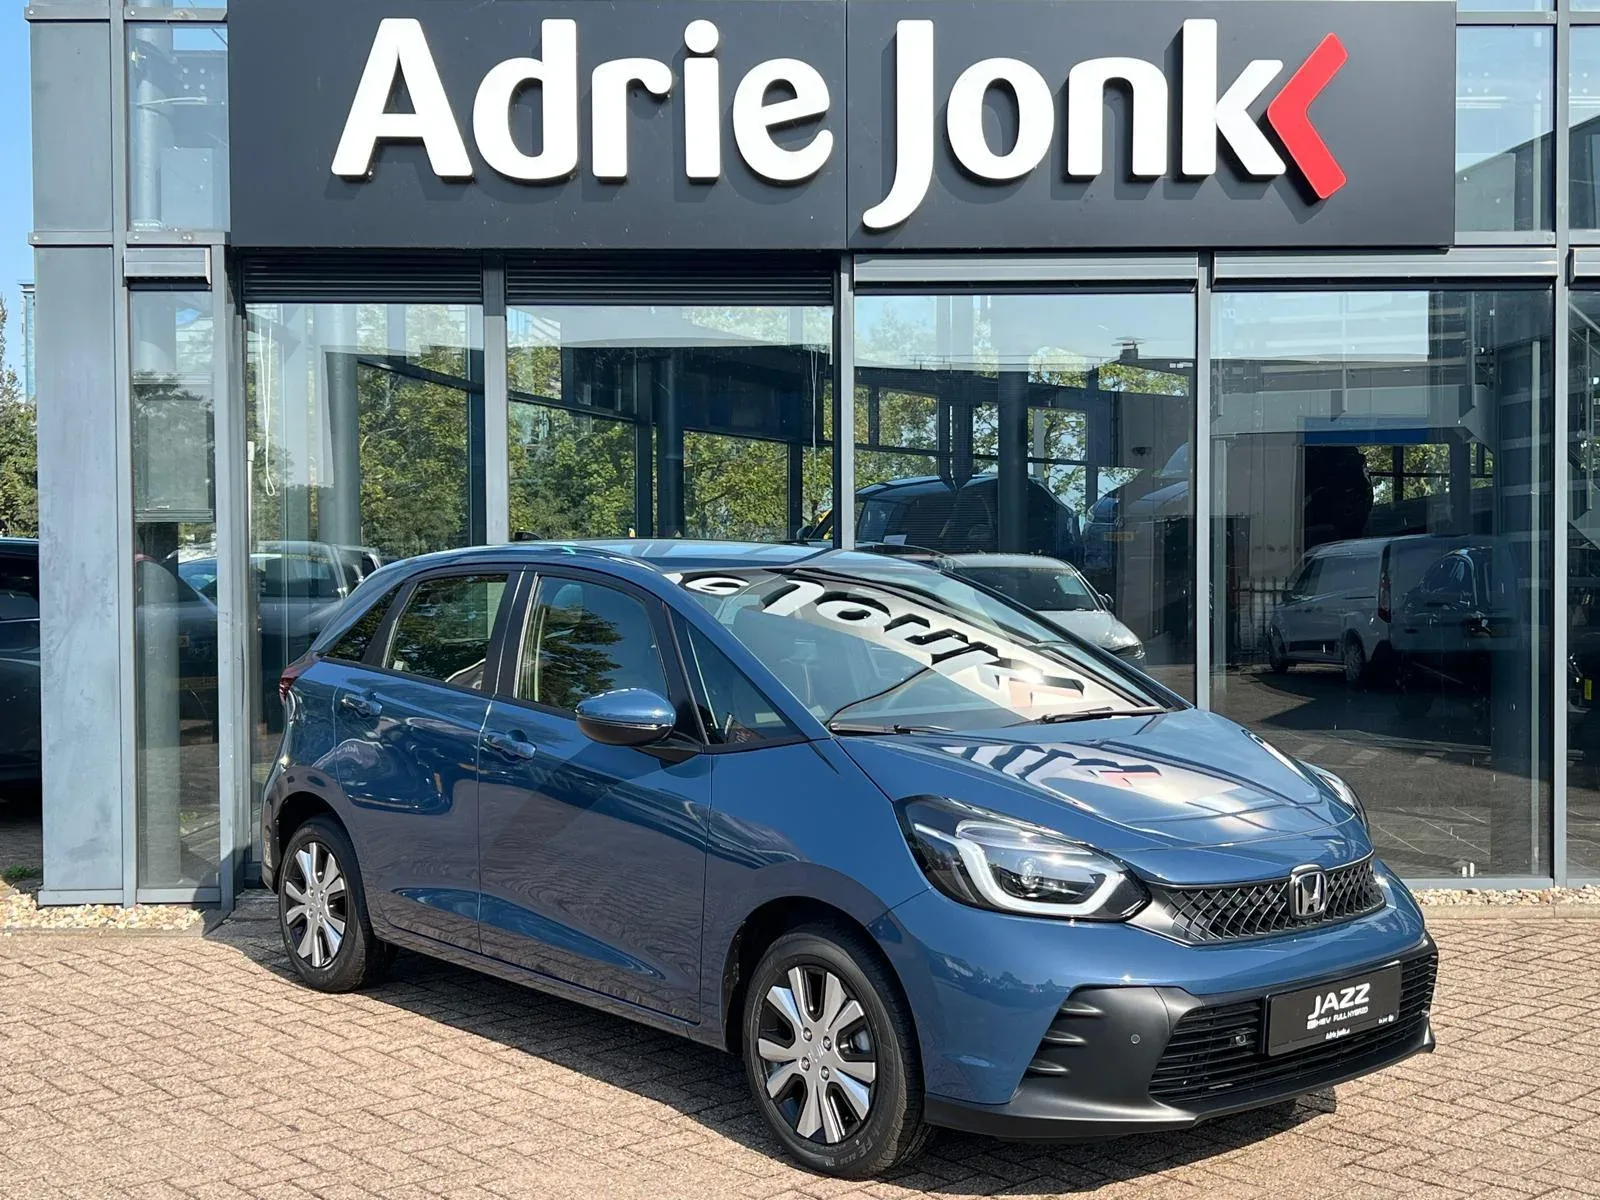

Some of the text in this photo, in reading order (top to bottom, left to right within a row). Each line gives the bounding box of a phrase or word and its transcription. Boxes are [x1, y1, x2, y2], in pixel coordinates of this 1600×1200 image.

[331, 17, 1287, 230] Adrie Jonk
[1307, 982, 1371, 1020] JAZZ
